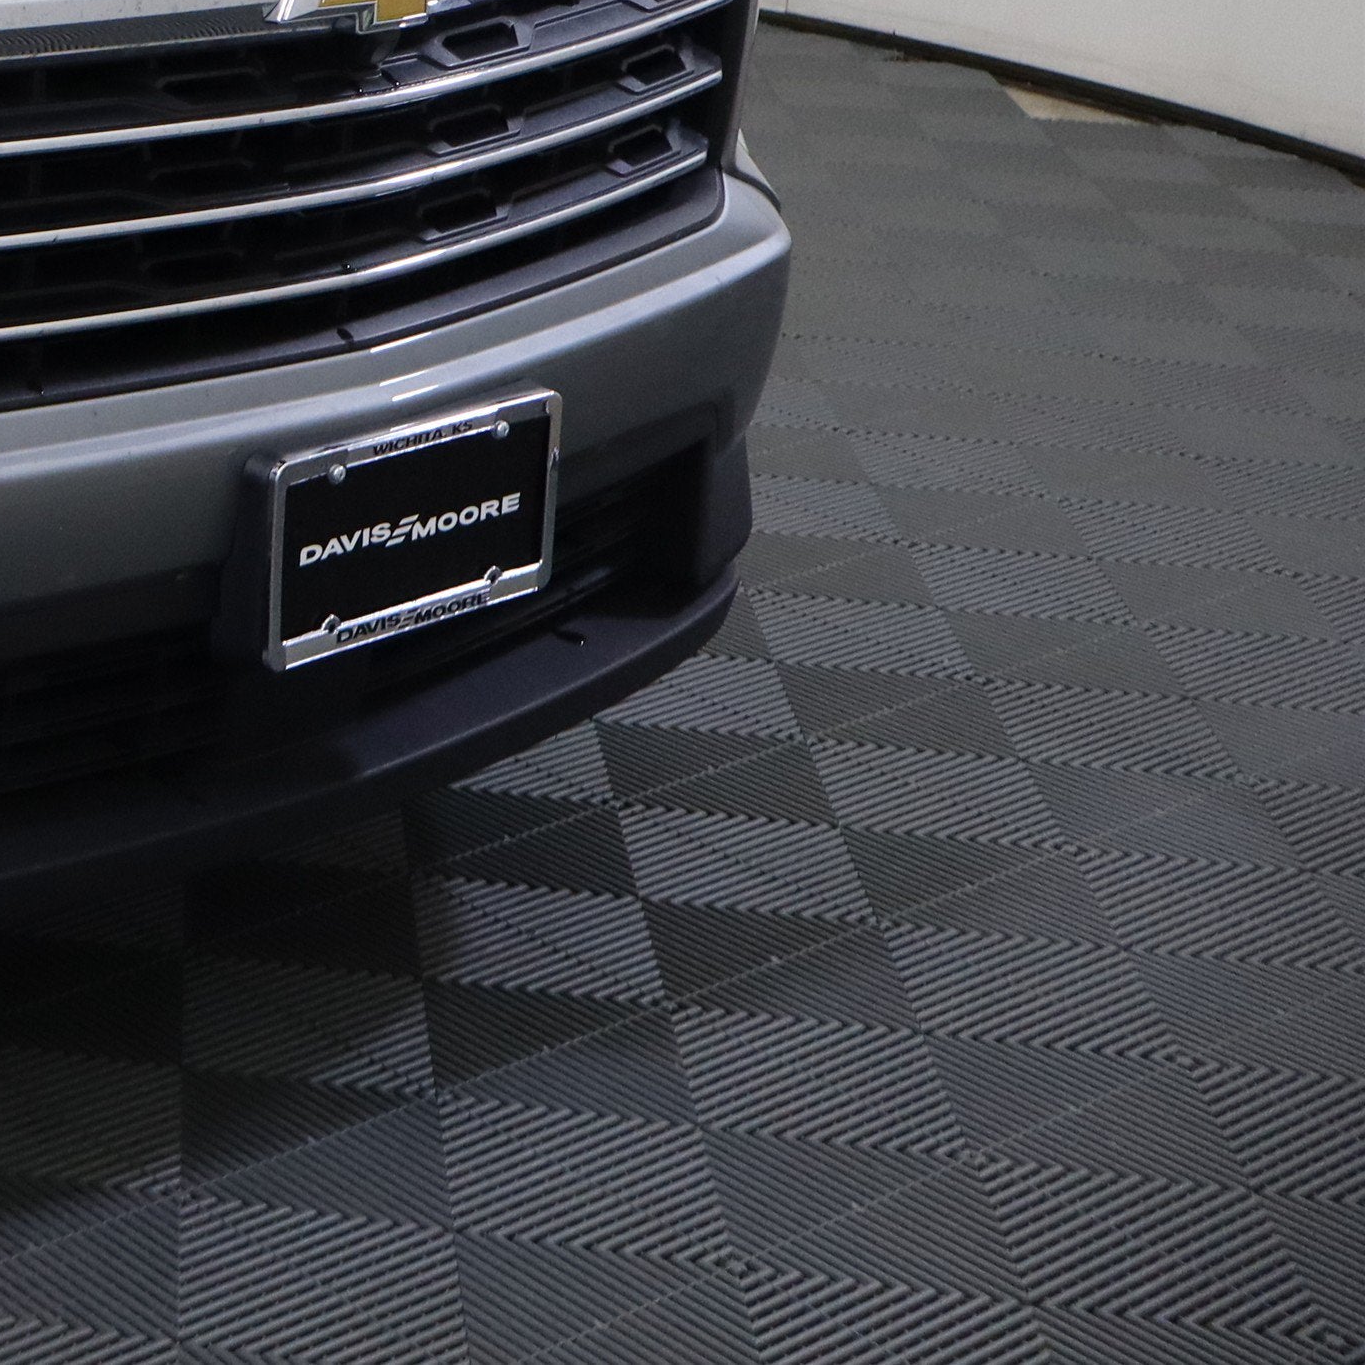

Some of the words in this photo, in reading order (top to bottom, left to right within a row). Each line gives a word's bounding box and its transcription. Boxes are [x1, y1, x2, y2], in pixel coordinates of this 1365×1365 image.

[452, 420, 473, 435] KS
[299, 522, 393, 566] DAVIS
[411, 492, 521, 541] MOORE
[336, 614, 401, 643] DAVIS
[414, 589, 491, 624] MOORE
